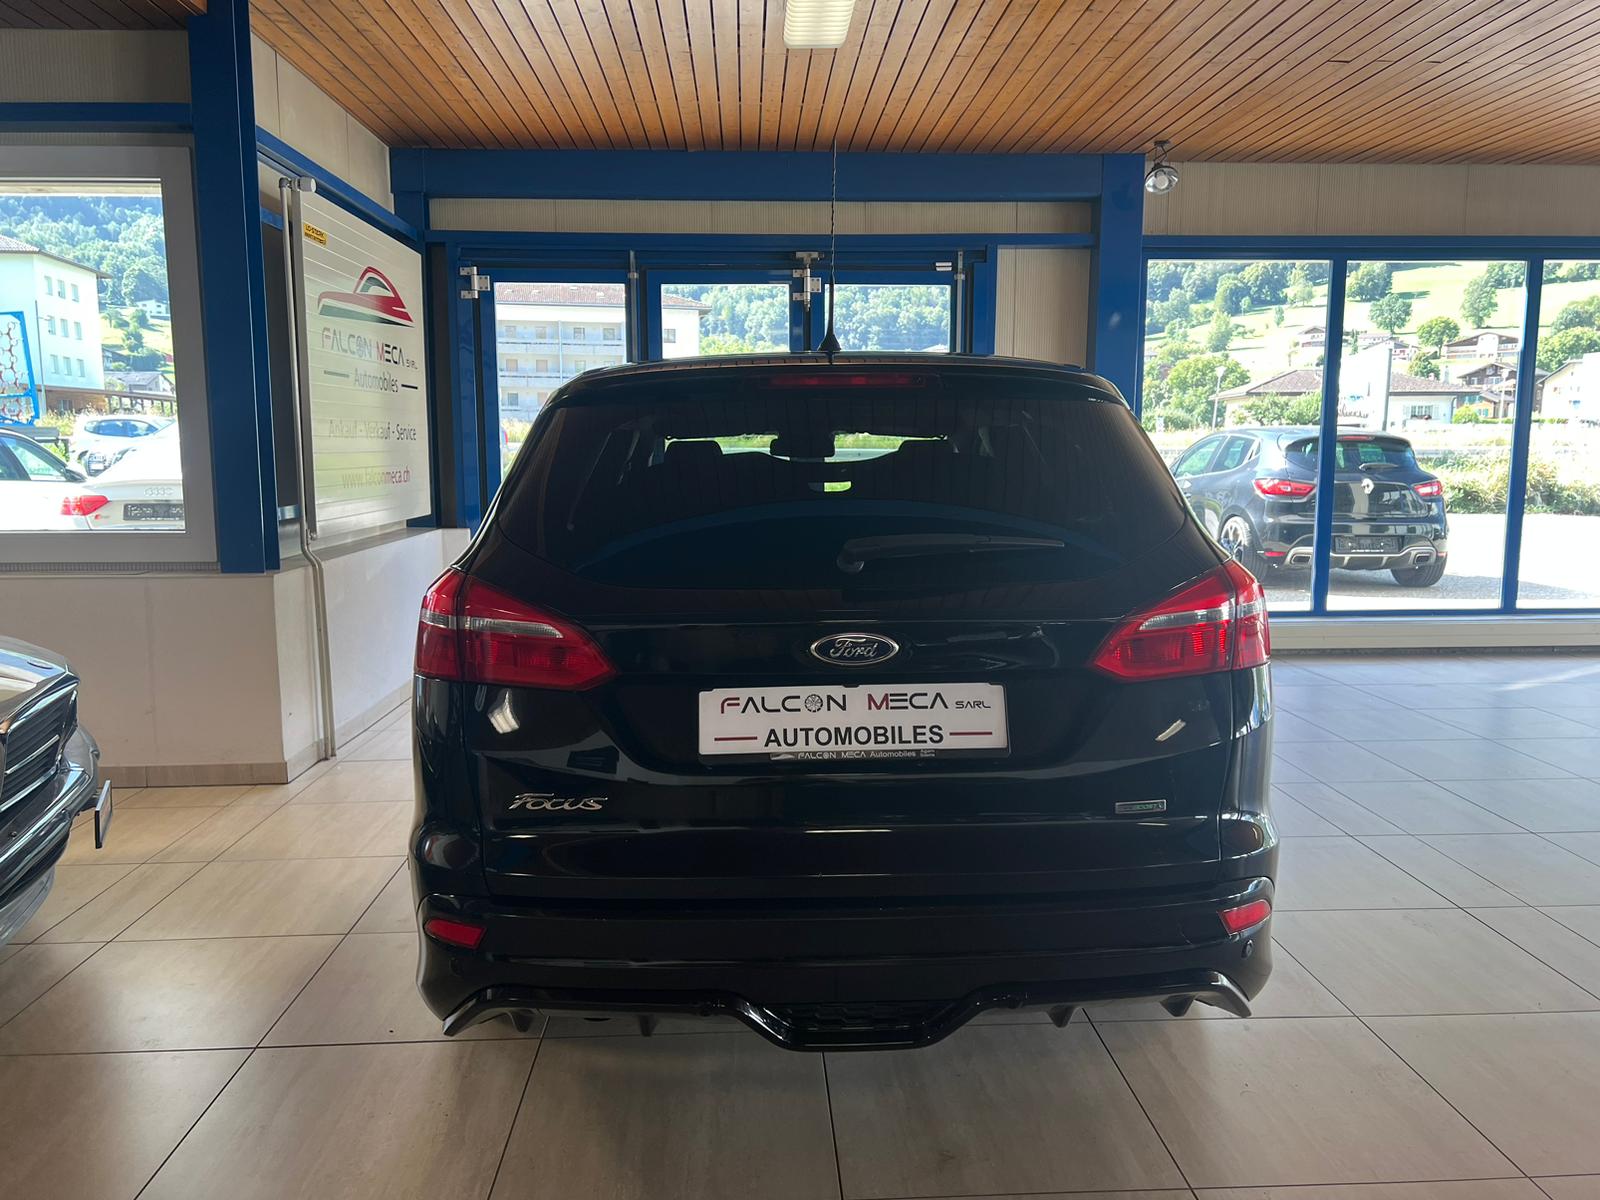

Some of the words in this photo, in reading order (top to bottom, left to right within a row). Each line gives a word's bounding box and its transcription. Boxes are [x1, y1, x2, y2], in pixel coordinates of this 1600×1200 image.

[321, 327, 373, 359] FALCON
[376, 341, 405, 367] MECA
[353, 367, 399, 393] Automobiles
[396, 423, 417, 441] Service
[829, 637, 878, 659] Ford
[720, 693, 847, 714] FALCON
[867, 692, 949, 711] MECA
[955, 700, 992, 710] SARL
[764, 724, 944, 748] AUTOMOBILES
[798, 751, 837, 759] FALCON
[841, 750, 866, 759] MECA
[870, 750, 916, 759] Automobiles
